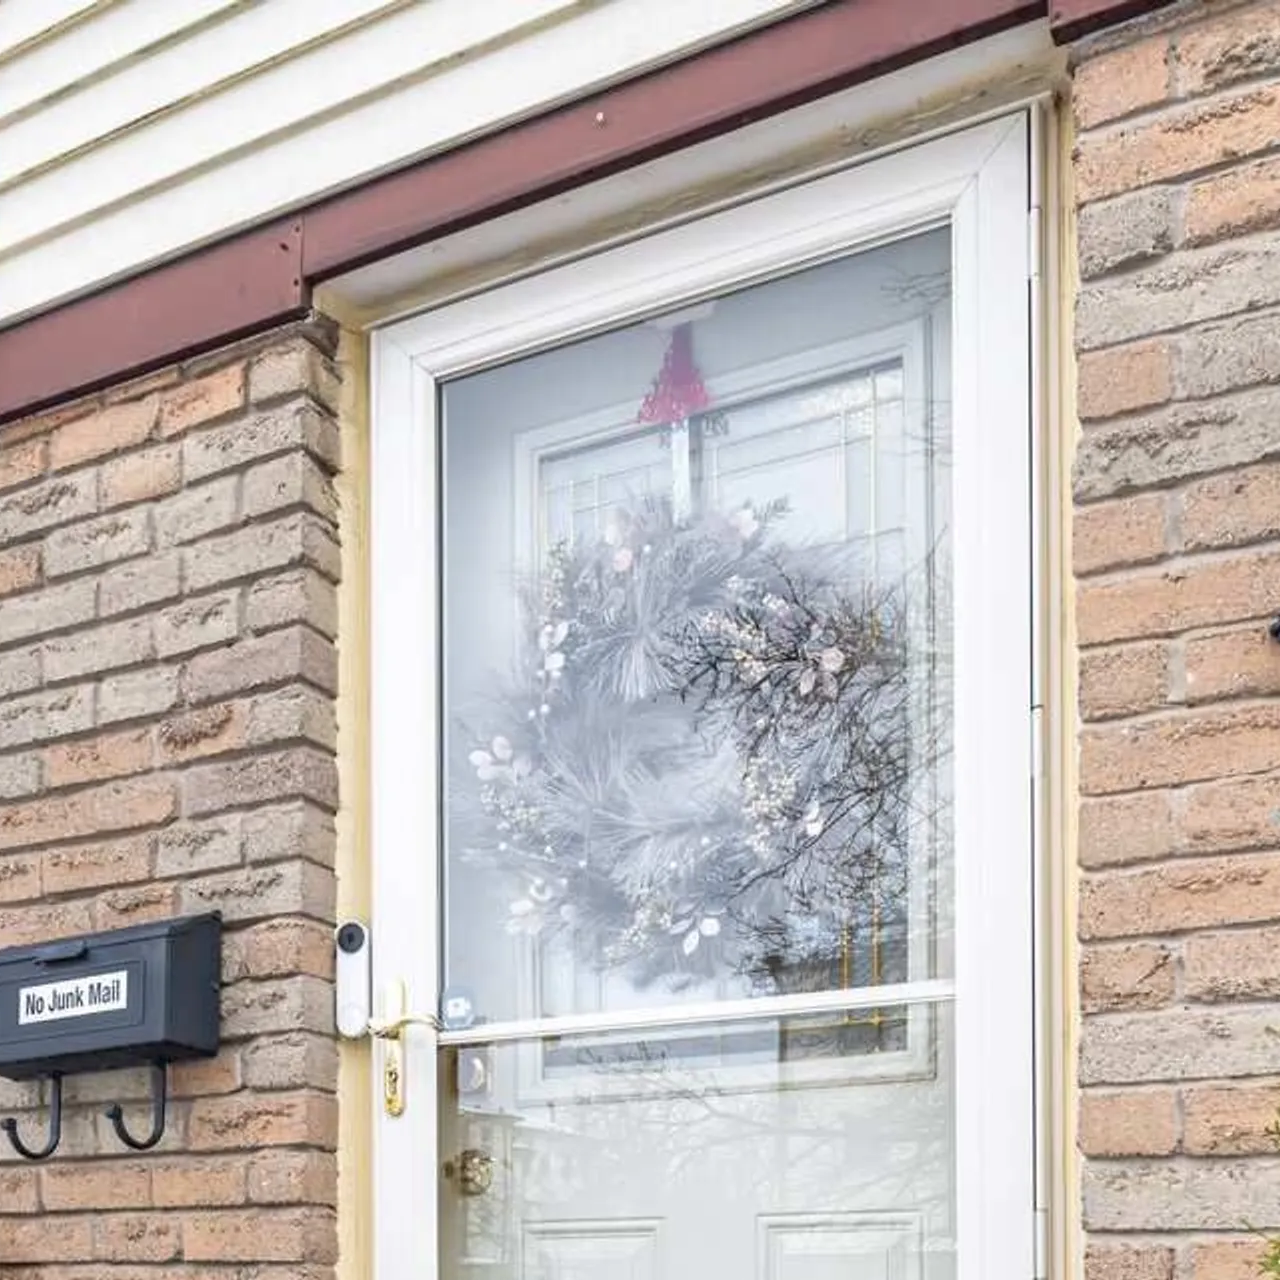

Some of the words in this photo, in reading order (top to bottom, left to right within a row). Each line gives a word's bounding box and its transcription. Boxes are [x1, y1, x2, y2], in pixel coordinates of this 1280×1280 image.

[25, 992, 45, 1016] No
[47, 985, 84, 1012] Junk
[87, 978, 120, 1006] Mail
